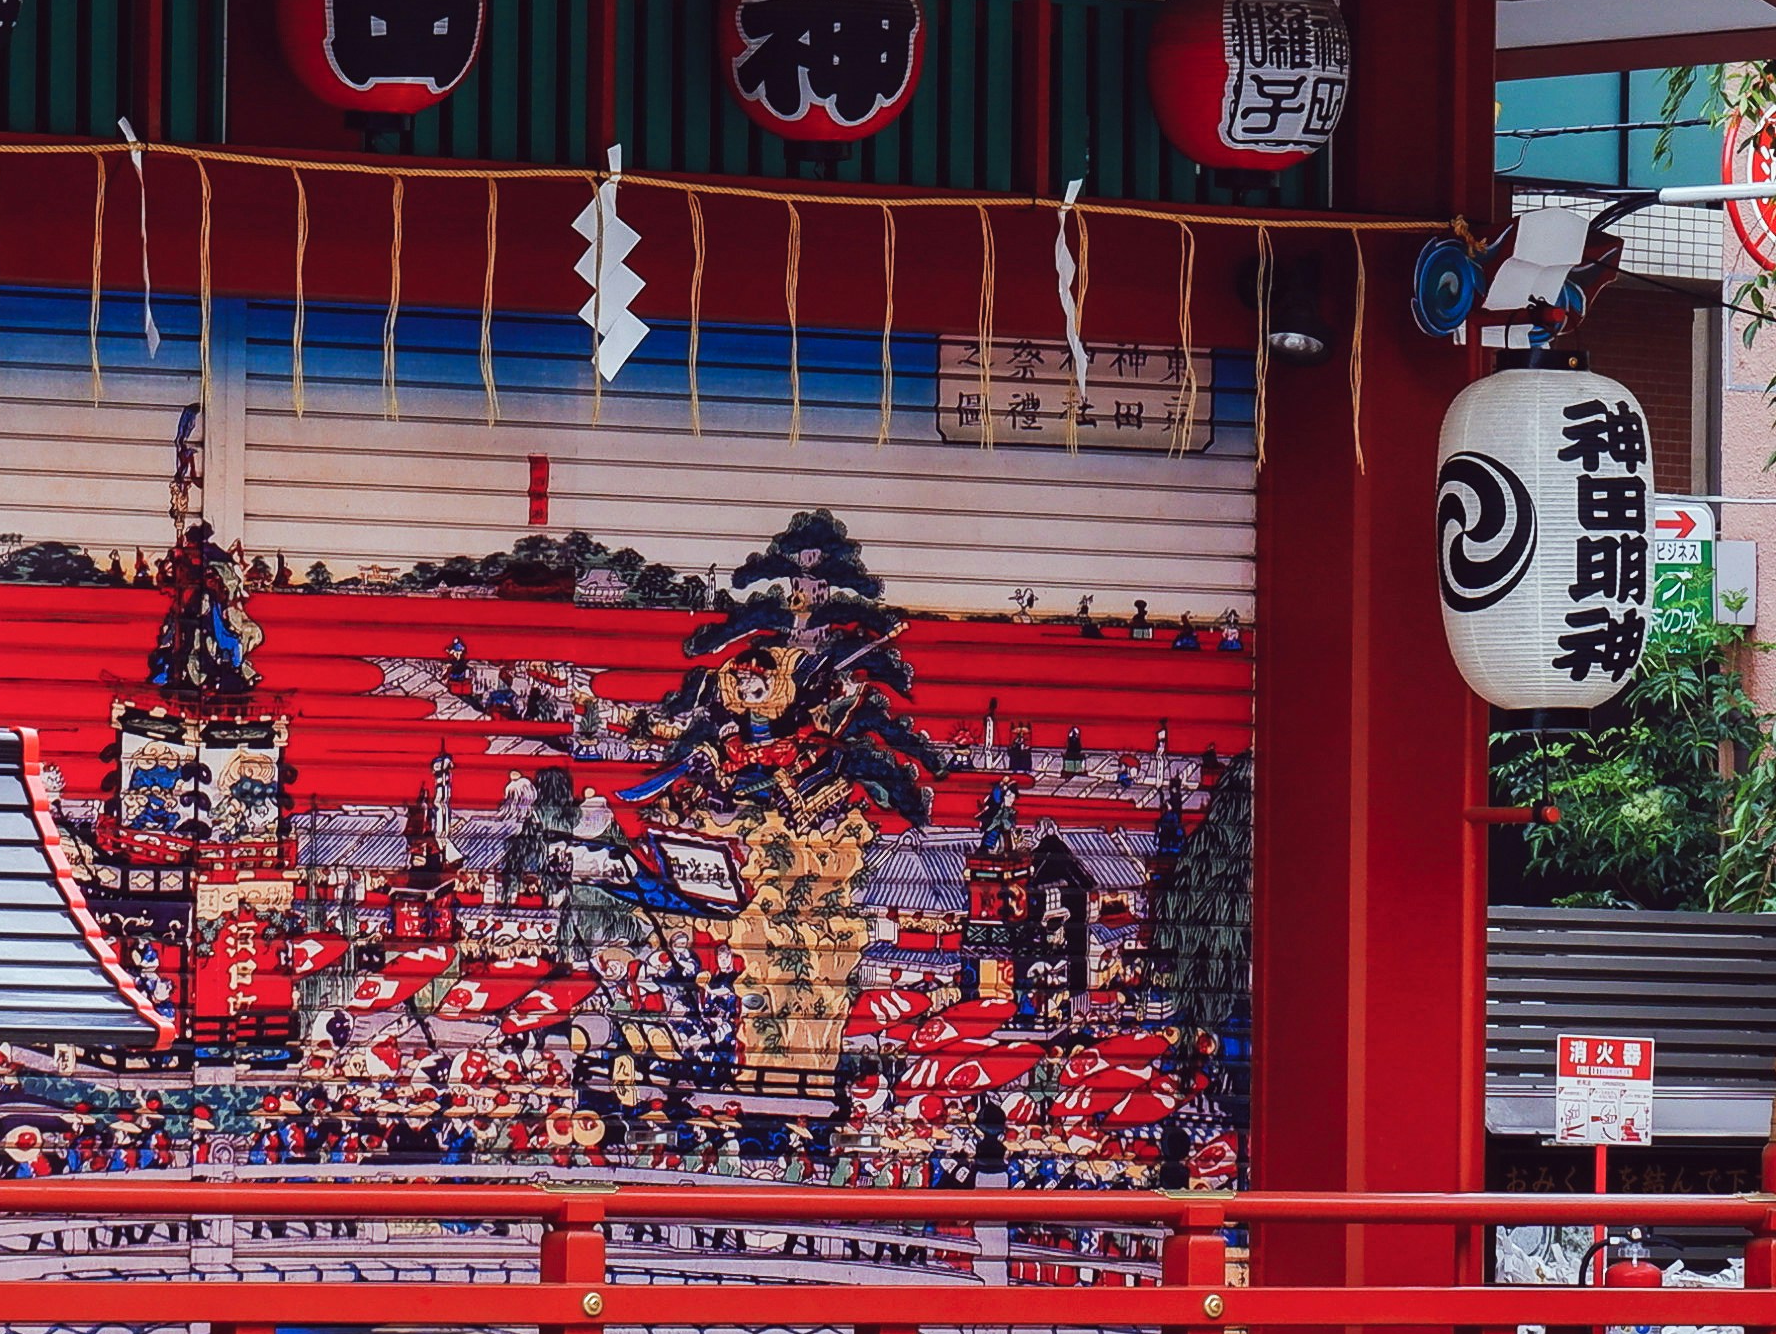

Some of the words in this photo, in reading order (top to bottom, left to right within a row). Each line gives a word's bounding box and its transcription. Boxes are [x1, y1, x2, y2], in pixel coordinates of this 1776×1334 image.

[1552, 398, 1650, 683] 神田明神
[1569, 1040, 1642, 1067] 消火器
